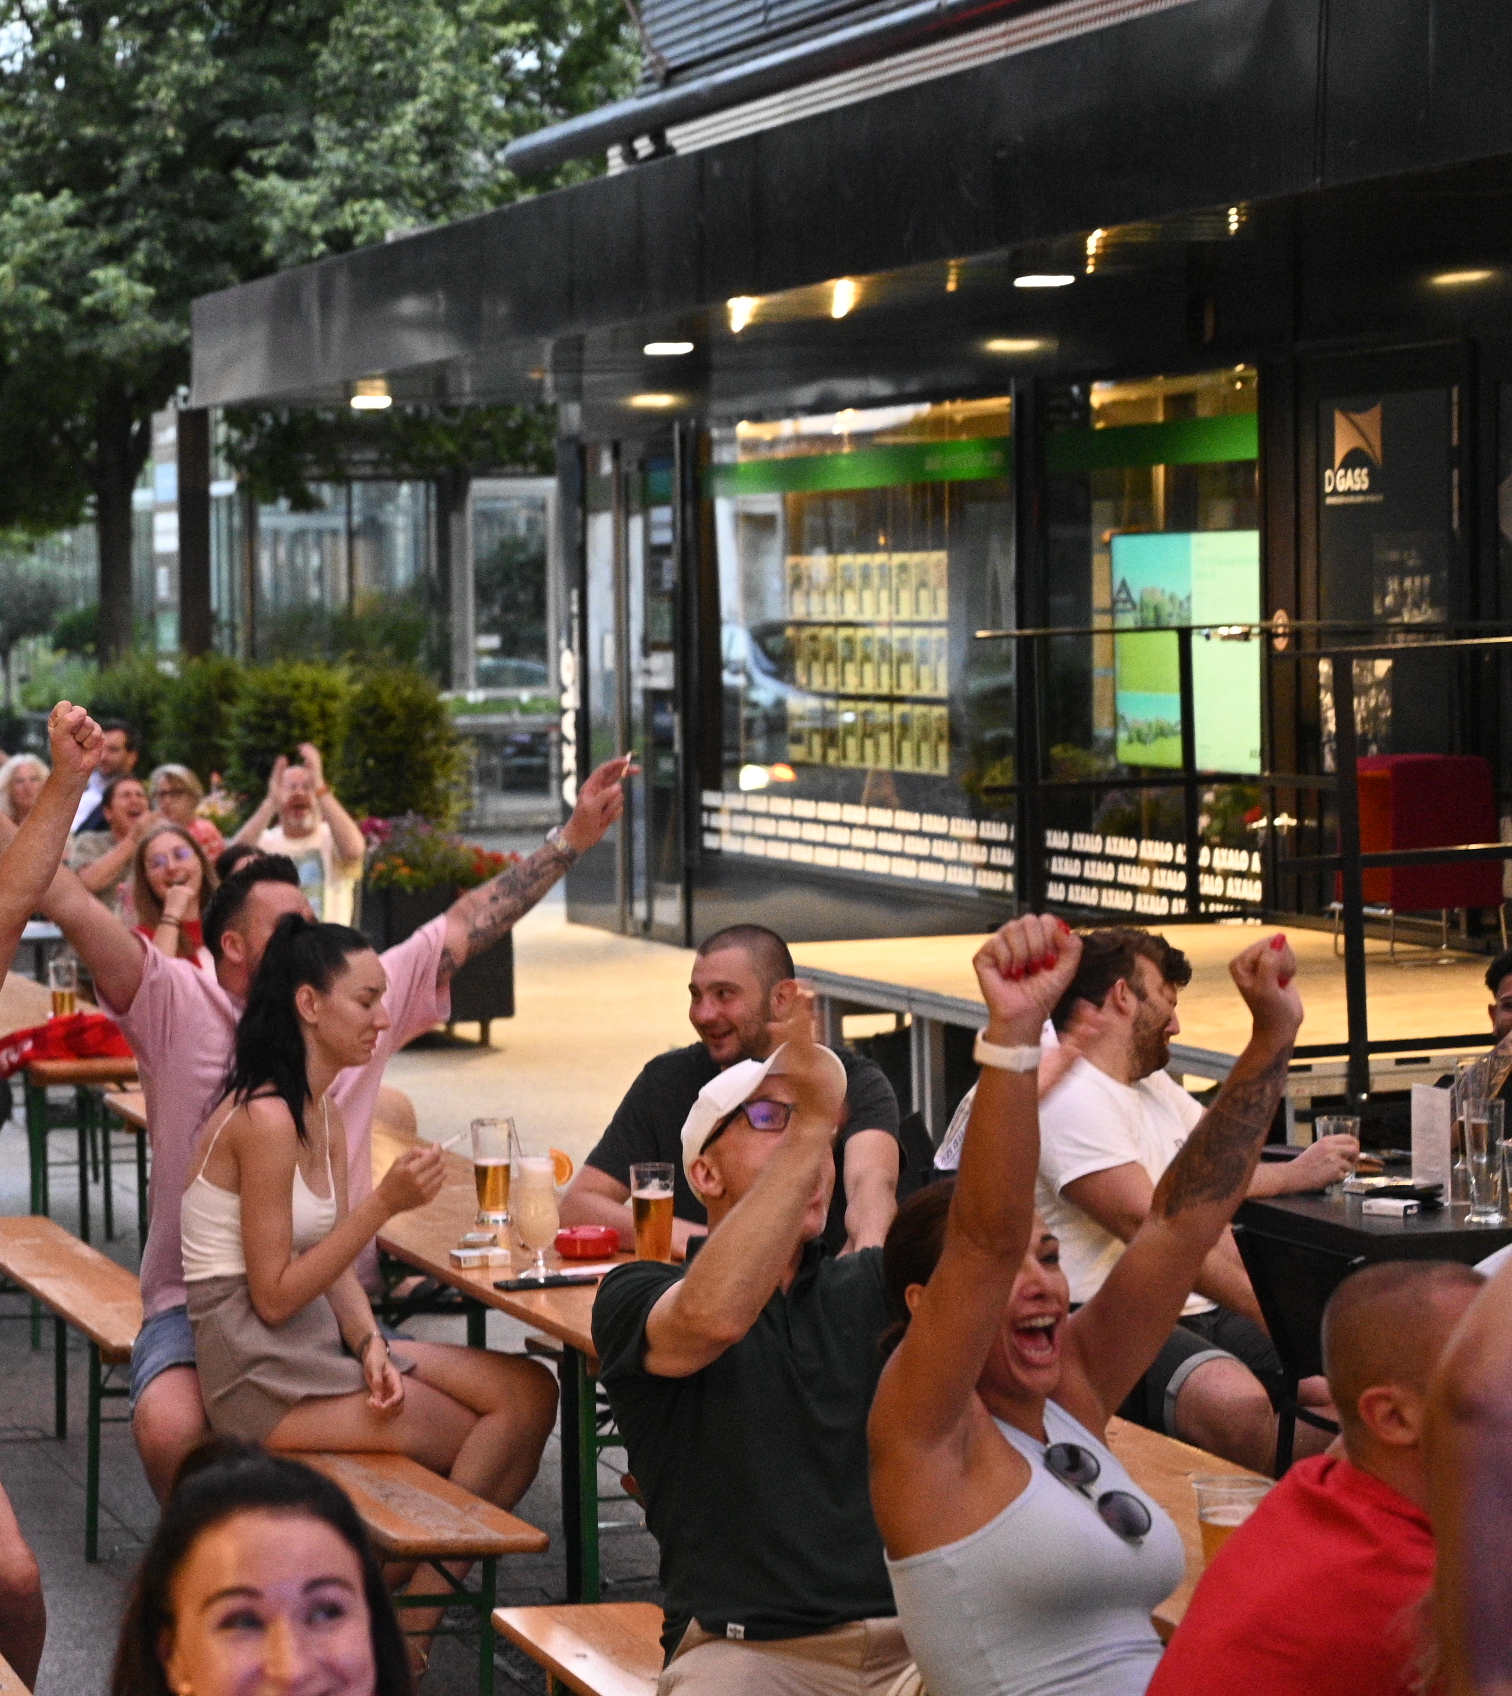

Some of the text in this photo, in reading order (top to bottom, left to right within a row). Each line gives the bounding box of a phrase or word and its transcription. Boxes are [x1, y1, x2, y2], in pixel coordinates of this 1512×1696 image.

[1046, 830, 1070, 849] XALO
[1071, 833, 1103, 853] AXALO
[1104, 836, 1138, 858] AXALO
[1138, 839, 1174, 862] AXALO
[1212, 847, 1250, 872] AXALO
[1047, 882, 1066, 901] ALO
[1068, 885, 1100, 905] AXALO
[1100, 889, 1134, 910] AXALO
[1135, 893, 1170, 915] AXALO
[1051, 856, 1082, 877] AXALO
[1083, 860, 1116, 881] AXALO
[1116, 864, 1151, 887] AXALO
[1152, 868, 1187, 891] AXALO
[1226, 877, 1263, 902] AXALO
